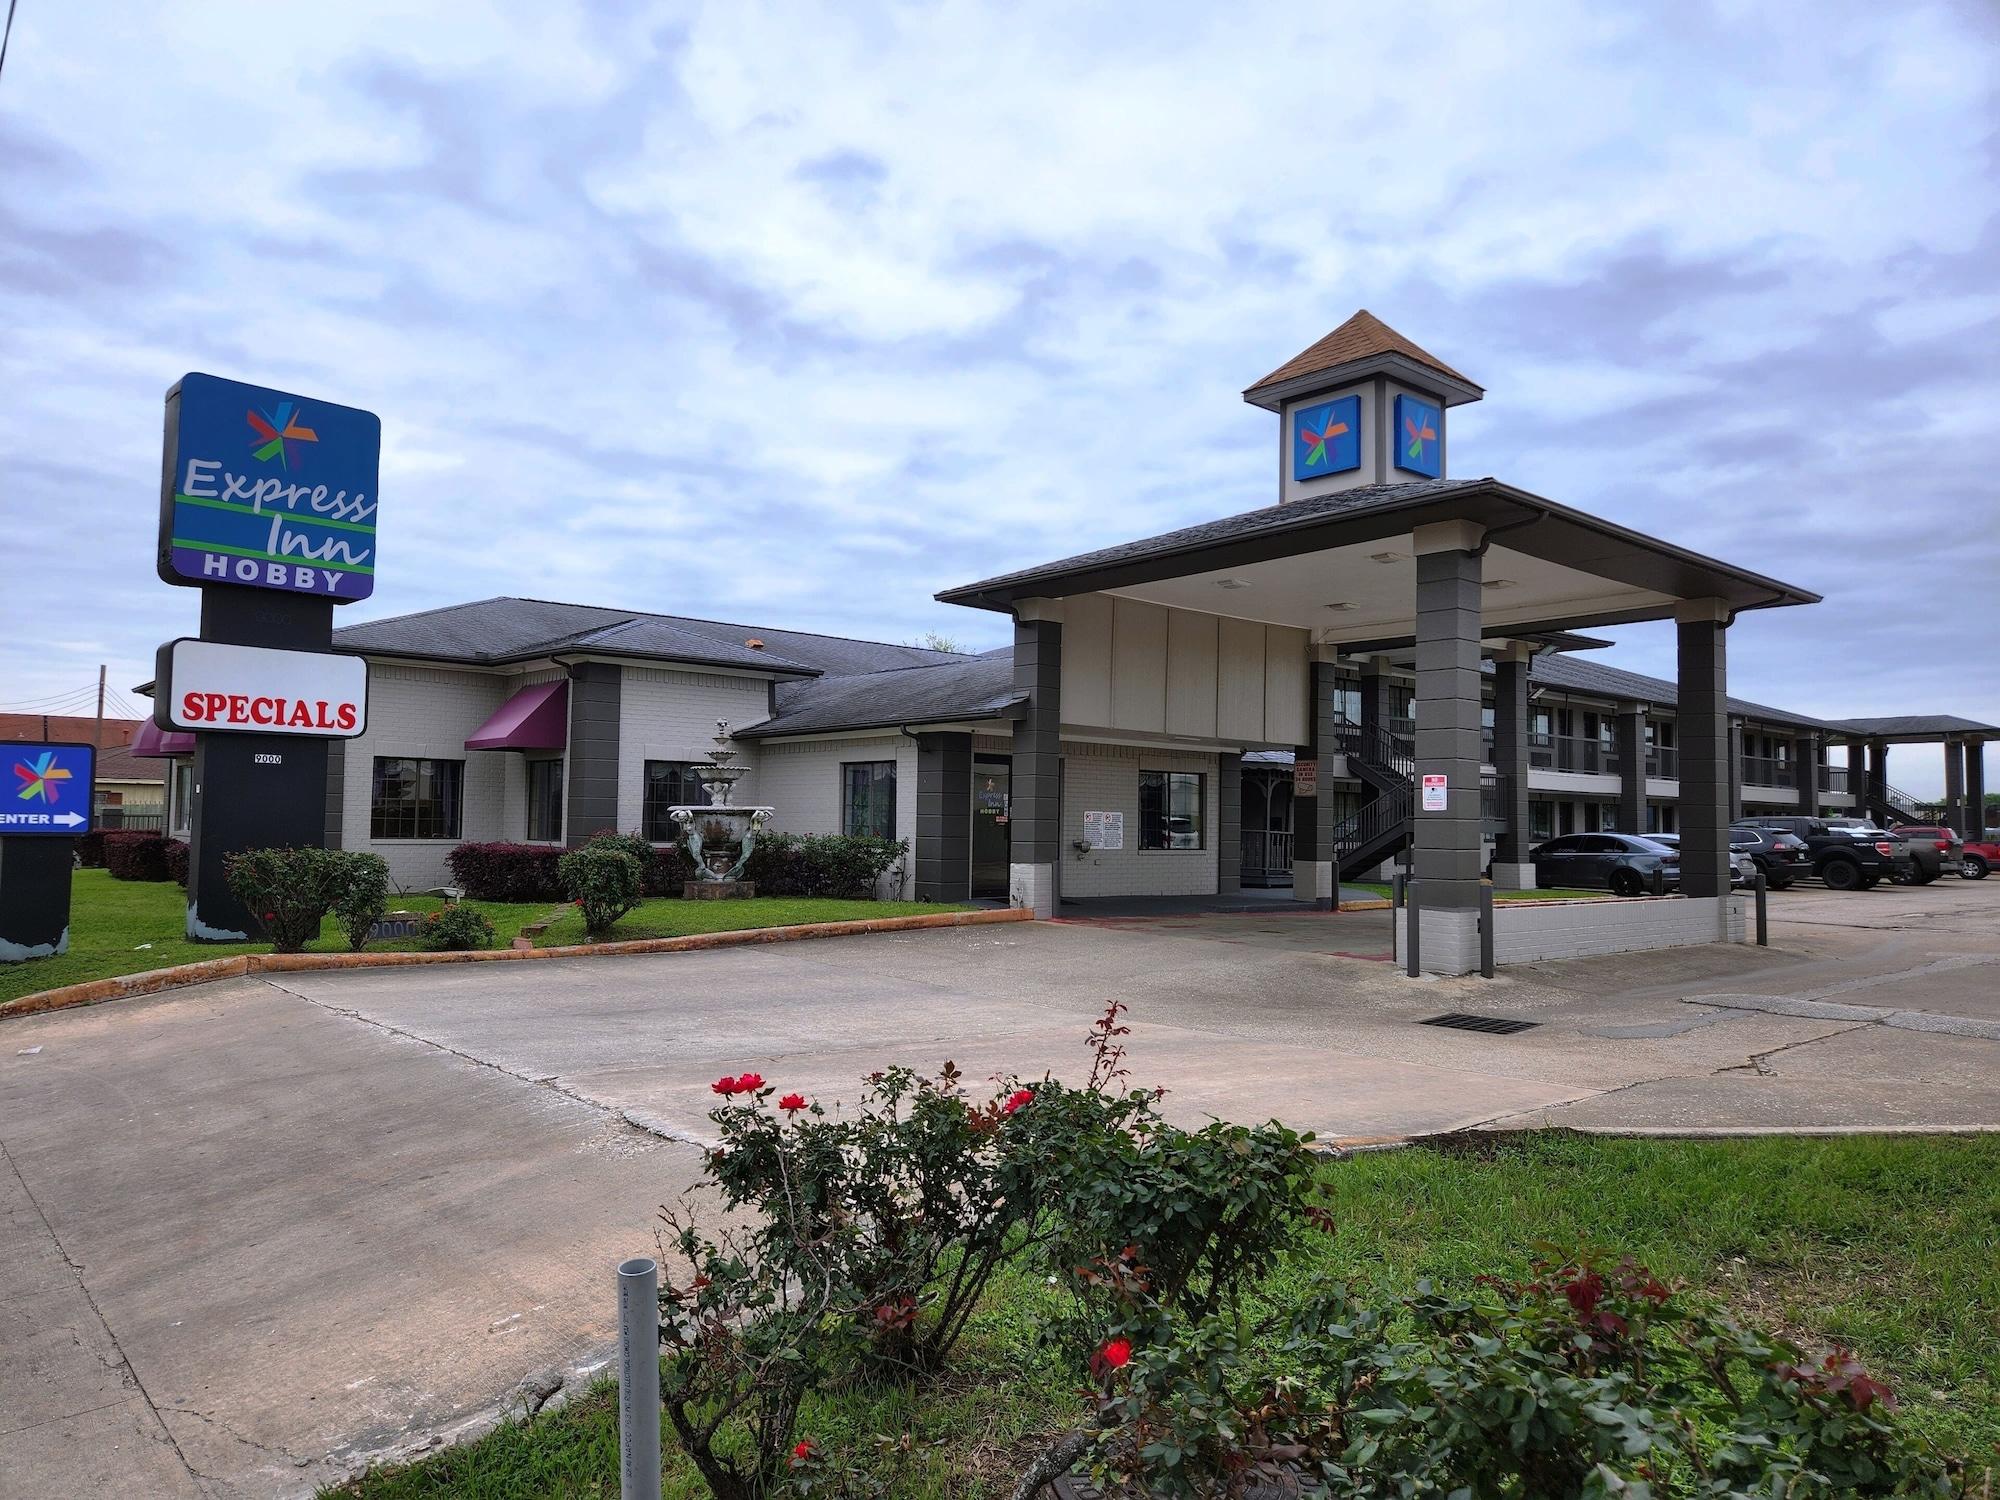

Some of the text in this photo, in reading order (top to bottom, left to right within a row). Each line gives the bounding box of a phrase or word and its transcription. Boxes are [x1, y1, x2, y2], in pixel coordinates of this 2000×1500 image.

[183, 458, 377, 523] Express
[267, 513, 370, 565] Inn
[203, 553, 344, 592] HOBBY
[182, 692, 357, 730] SPECIALS
[256, 755, 281, 763] 9000
[0, 814, 50, 825] ENTER
